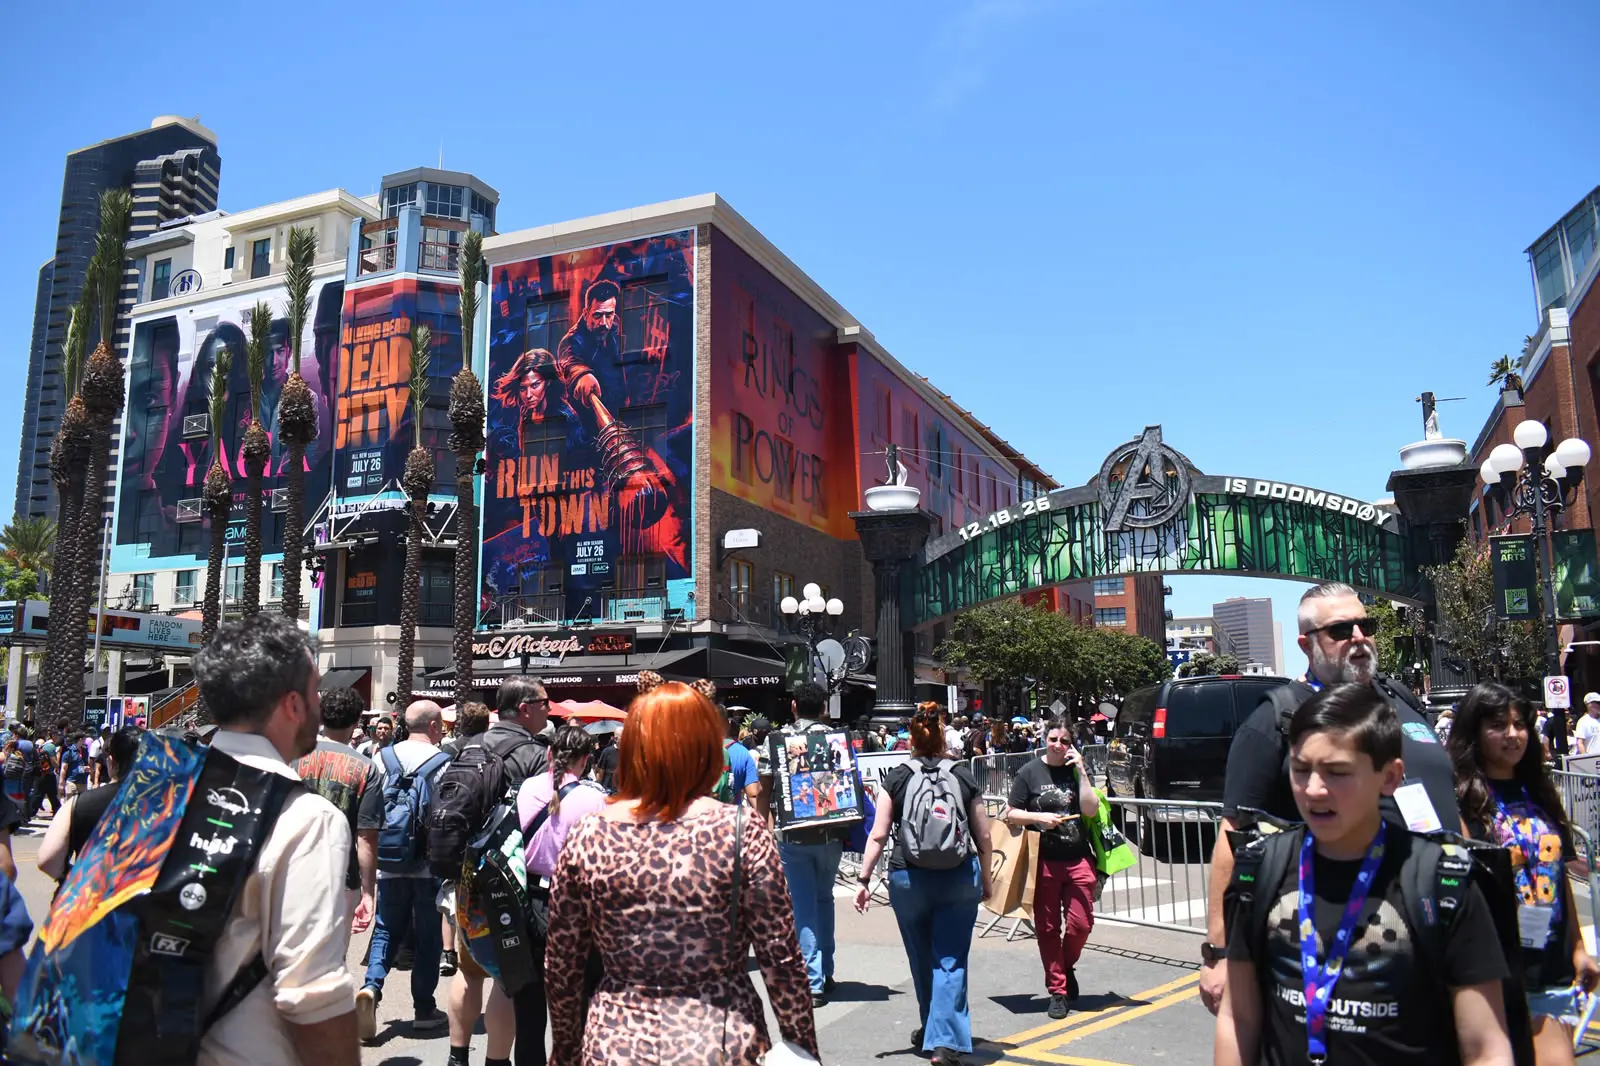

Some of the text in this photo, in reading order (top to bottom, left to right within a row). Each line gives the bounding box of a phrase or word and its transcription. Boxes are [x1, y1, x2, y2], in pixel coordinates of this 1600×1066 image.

[382, 318, 411, 338] DEAD
[742, 330, 824, 432] RINGS
[778, 411, 794, 437] OF
[351, 458, 381, 473] JULY 26
[736, 412, 828, 511] POWER
[496, 453, 595, 498] RUN THIS
[1224, 478, 1248, 494] IS
[520, 491, 609, 538] TOWN
[576, 545, 604, 557] JULY 26
[1500, 553, 1526, 562] ARTS
[148, 627, 171, 635] LIVES
[149, 620, 182, 629] FANDOM
[147, 633, 169, 641] HERE
[489, 634, 585, 663] Mickey's
[430, 679, 457, 688] FAMO
[733, 676, 780, 686] SINCE 1945
[183, 889, 204, 902] abc
[157, 937, 182, 952] FX
[1281, 985, 1308, 1007] WEN
